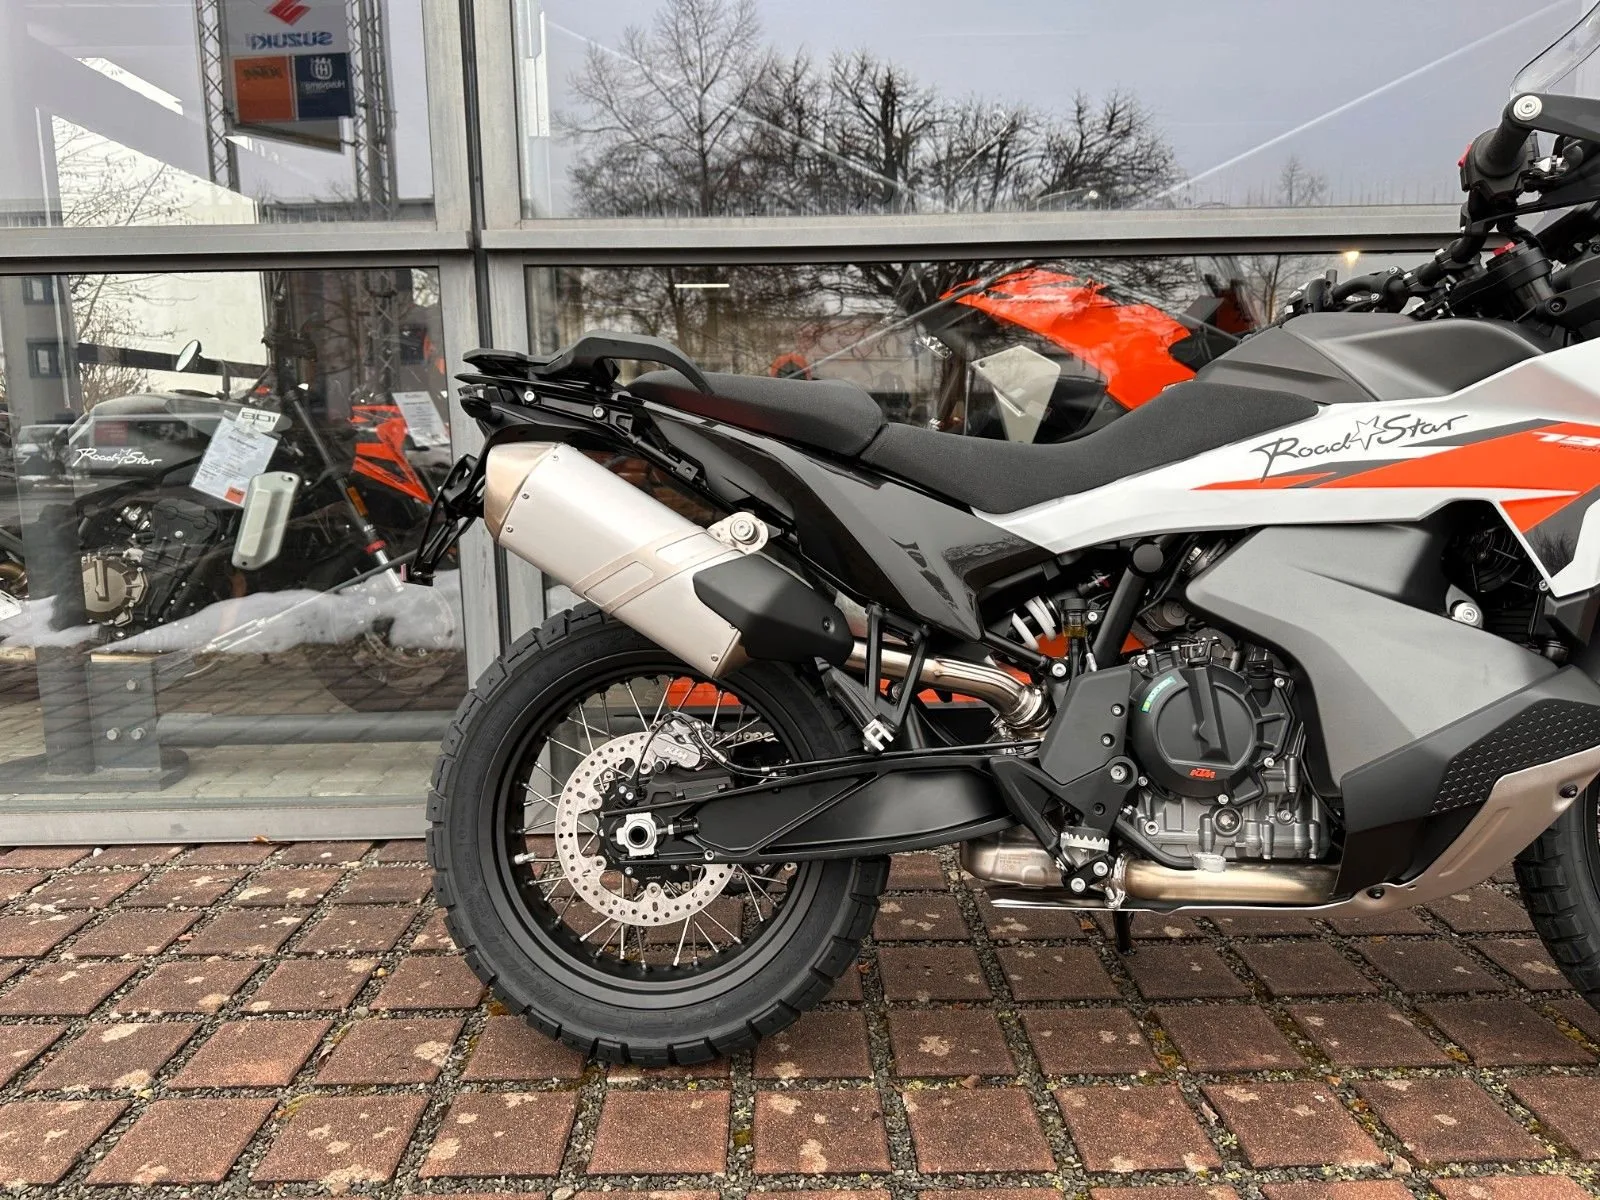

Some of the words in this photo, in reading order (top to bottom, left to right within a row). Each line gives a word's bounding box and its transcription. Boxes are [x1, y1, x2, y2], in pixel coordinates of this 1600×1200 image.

[72, 447, 120, 467] Road
[124, 451, 163, 466] Star
[1249, 433, 1351, 483] Road
[1377, 414, 1469, 444] Star
[1189, 767, 1216, 779] KTM
